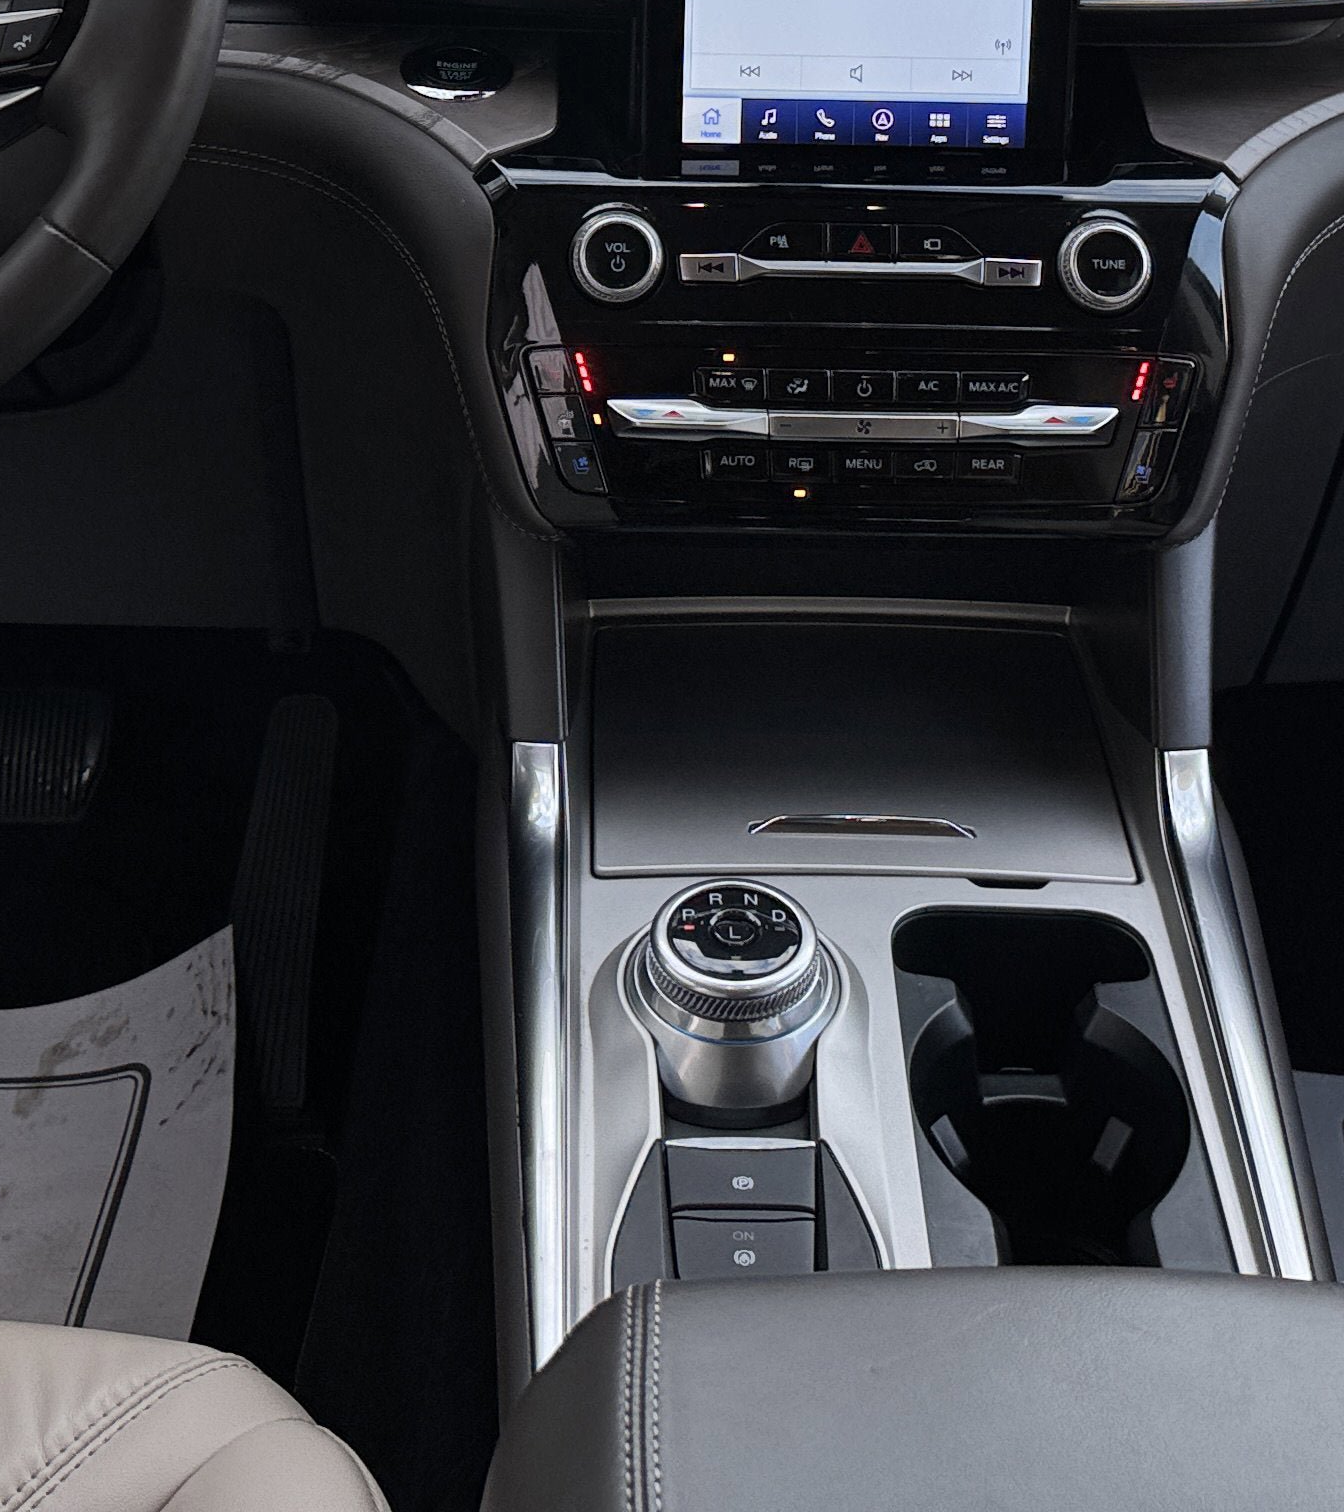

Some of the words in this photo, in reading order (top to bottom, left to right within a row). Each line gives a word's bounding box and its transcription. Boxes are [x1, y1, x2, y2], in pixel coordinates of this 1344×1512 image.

[700, 130, 722, 139] Home
[605, 242, 631, 254] VOL
[1091, 258, 1127, 271] TUNE
[709, 377, 738, 389] MAX
[918, 379, 940, 393] A/C
[968, 381, 994, 393] MAX
[995, 381, 1019, 395] A/C
[719, 454, 756, 468] AUTO
[845, 457, 883, 470] MENU
[971, 458, 1005, 471] REAR
[709, 892, 724, 905] R
[743, 893, 759, 906] N
[682, 908, 696, 921] P
[771, 909, 787, 923] D
[728, 926, 742, 940] L
[732, 1231, 755, 1241] ON
